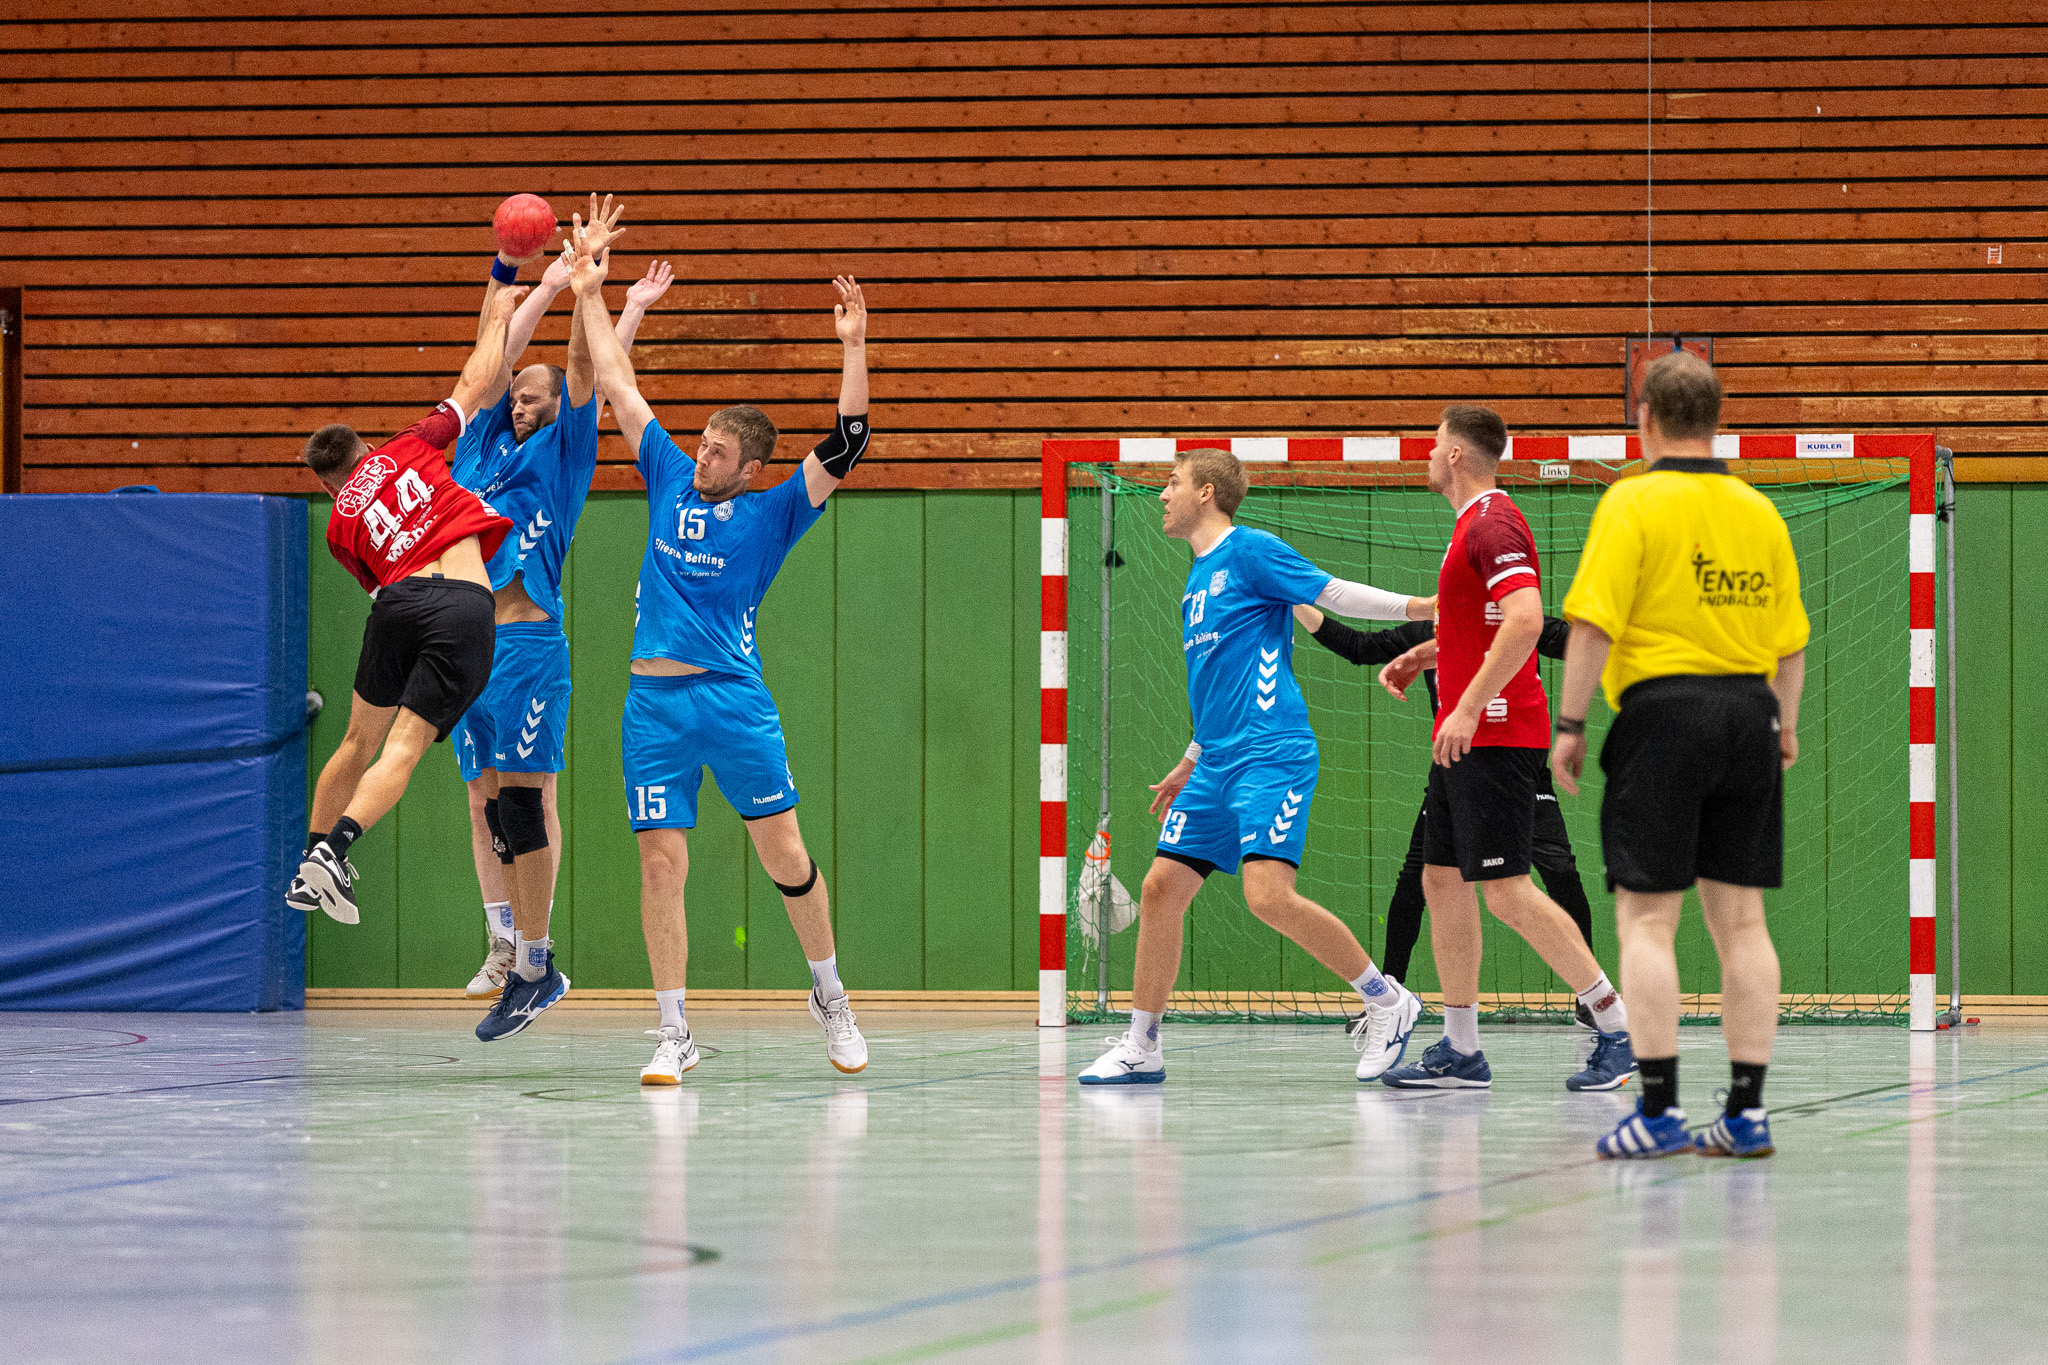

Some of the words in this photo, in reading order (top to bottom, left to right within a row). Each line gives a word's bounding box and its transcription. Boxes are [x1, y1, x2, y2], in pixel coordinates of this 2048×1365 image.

[1542, 465, 1568, 476] Links
[362, 467, 435, 552] 44
[678, 508, 708, 540] 15
[1190, 590, 1206, 627] 13
[635, 785, 667, 821] 15
[753, 790, 784, 805] hummel
[1159, 808, 1187, 845] 13
[1482, 858, 1504, 867] JAKO
